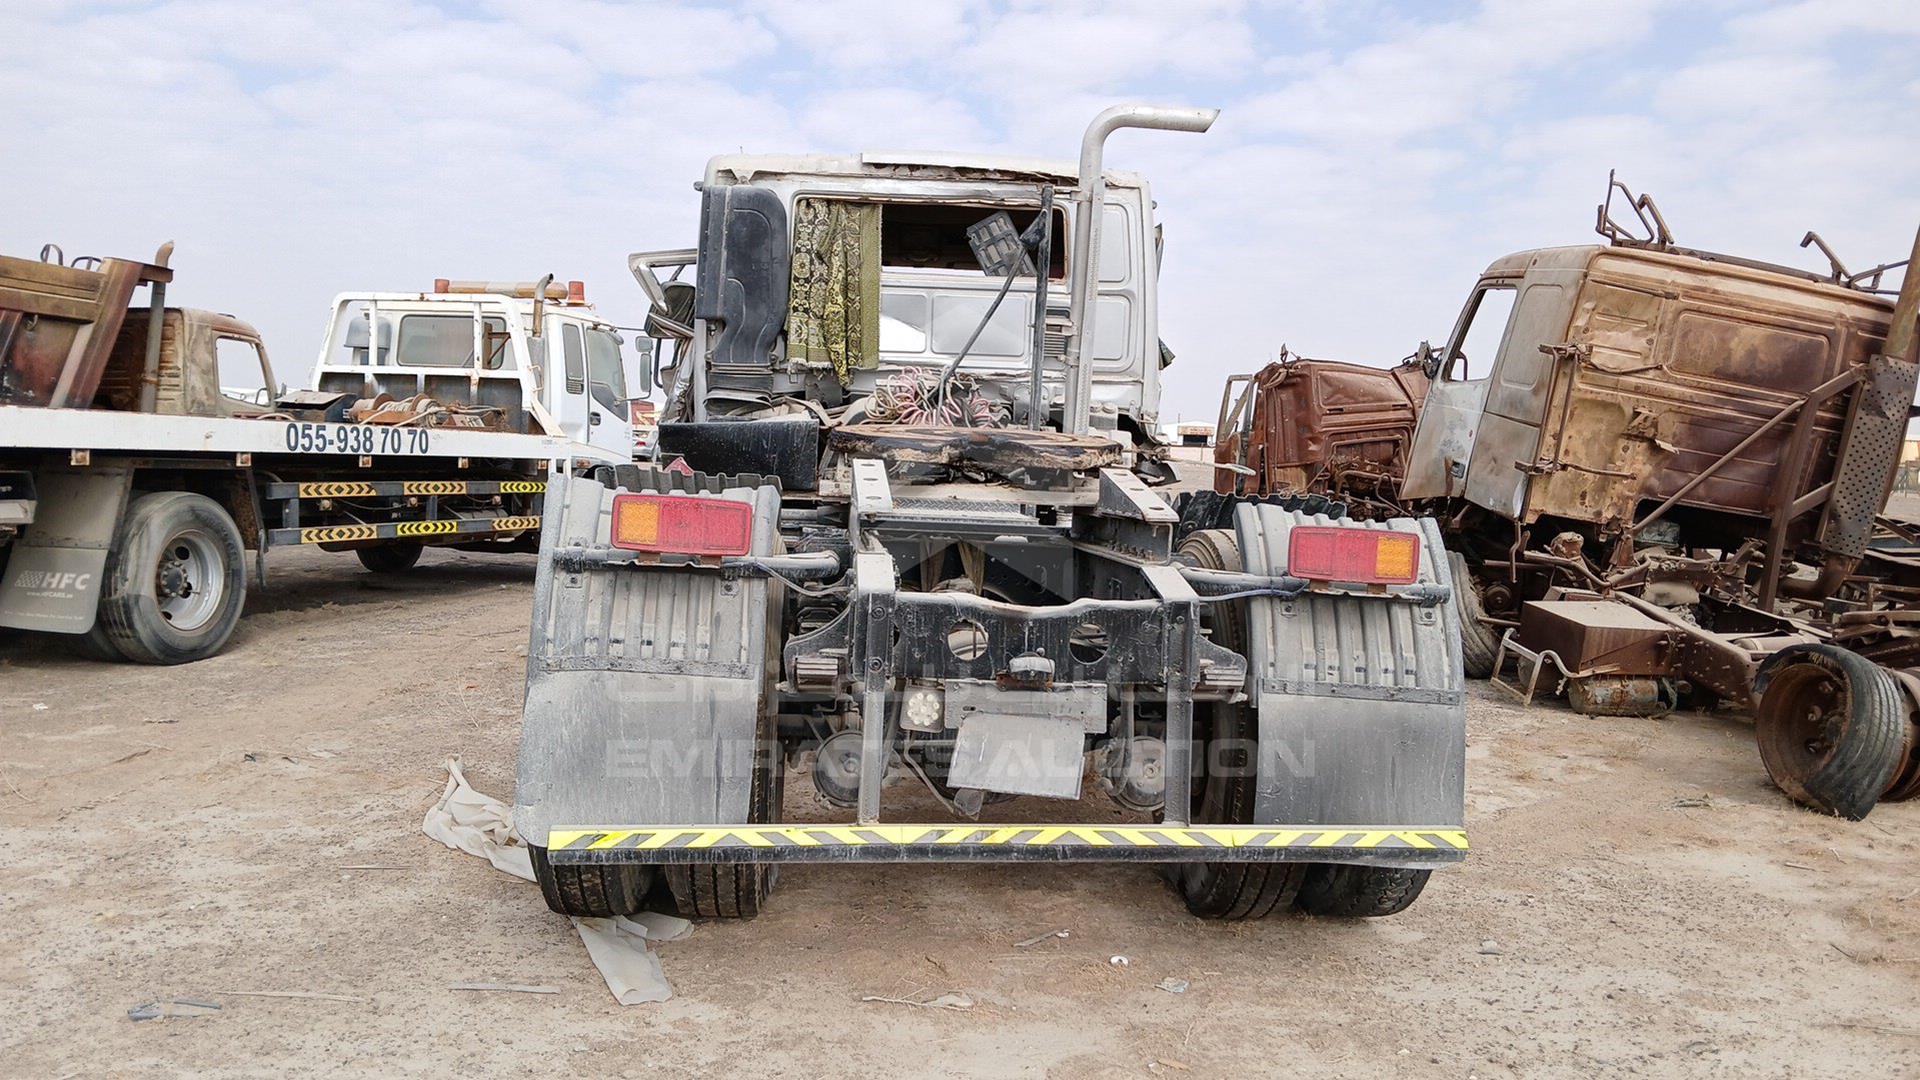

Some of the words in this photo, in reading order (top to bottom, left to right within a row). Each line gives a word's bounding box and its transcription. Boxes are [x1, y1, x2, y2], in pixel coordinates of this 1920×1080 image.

[286, 422, 374, 453] 055-938
[380, 427, 401, 454] 70
[407, 428, 429, 454] 70
[41, 572, 91, 590] HFC
